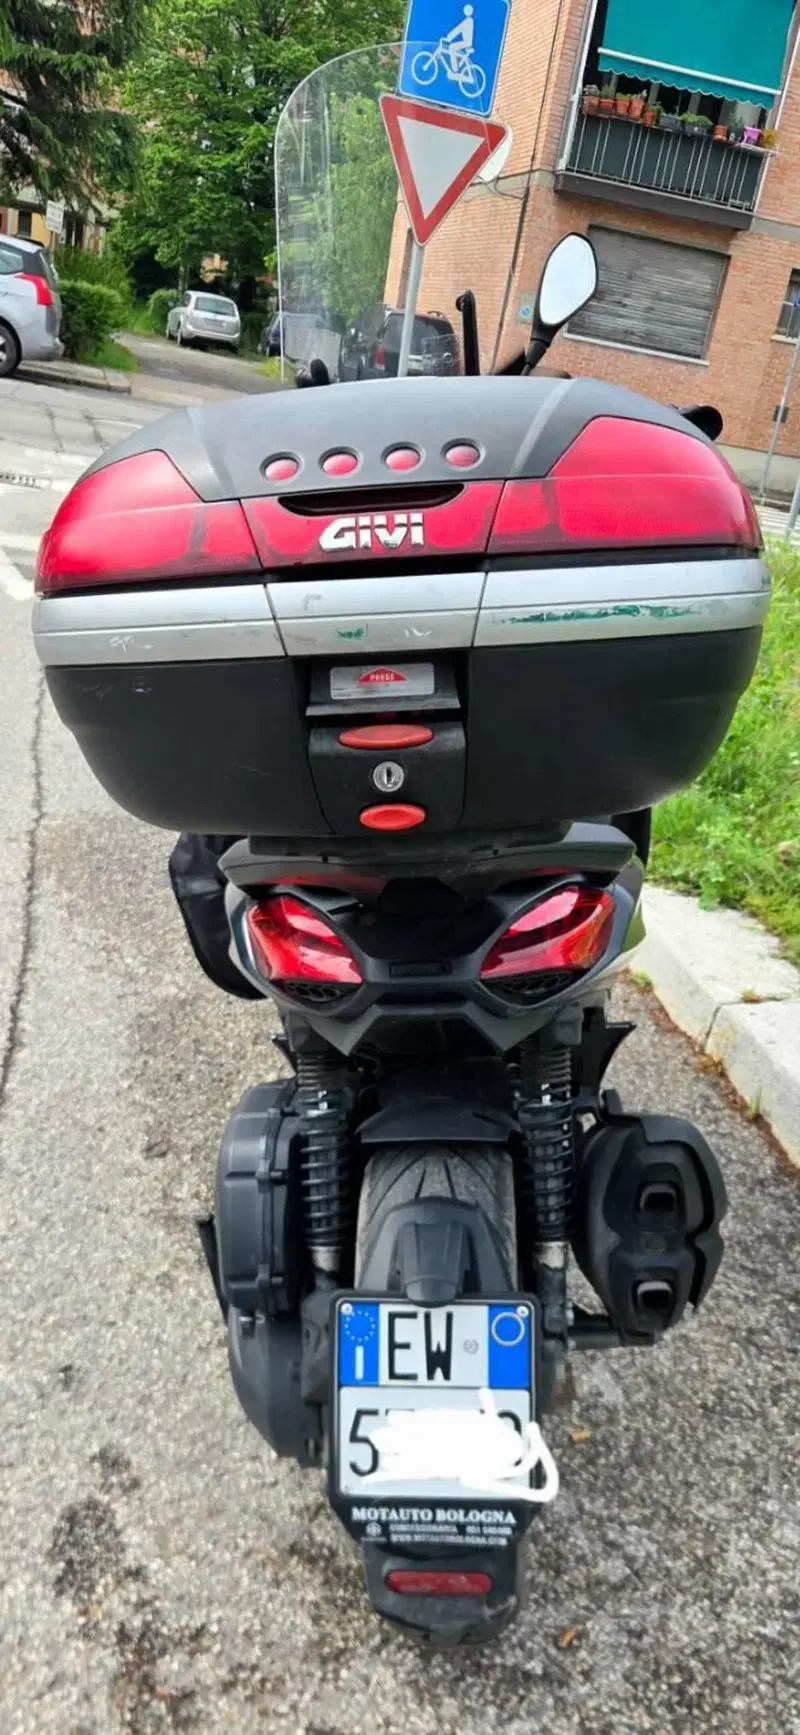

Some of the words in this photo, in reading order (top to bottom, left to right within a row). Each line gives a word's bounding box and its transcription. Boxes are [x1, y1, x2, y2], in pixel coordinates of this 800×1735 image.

[319, 512, 424, 551] GIVI
[369, 673, 395, 681] PRESS
[387, 1310, 454, 1381] EW
[351, 1505, 433, 1521] MOTAUTO
[434, 1507, 517, 1524] BOLOGNA
